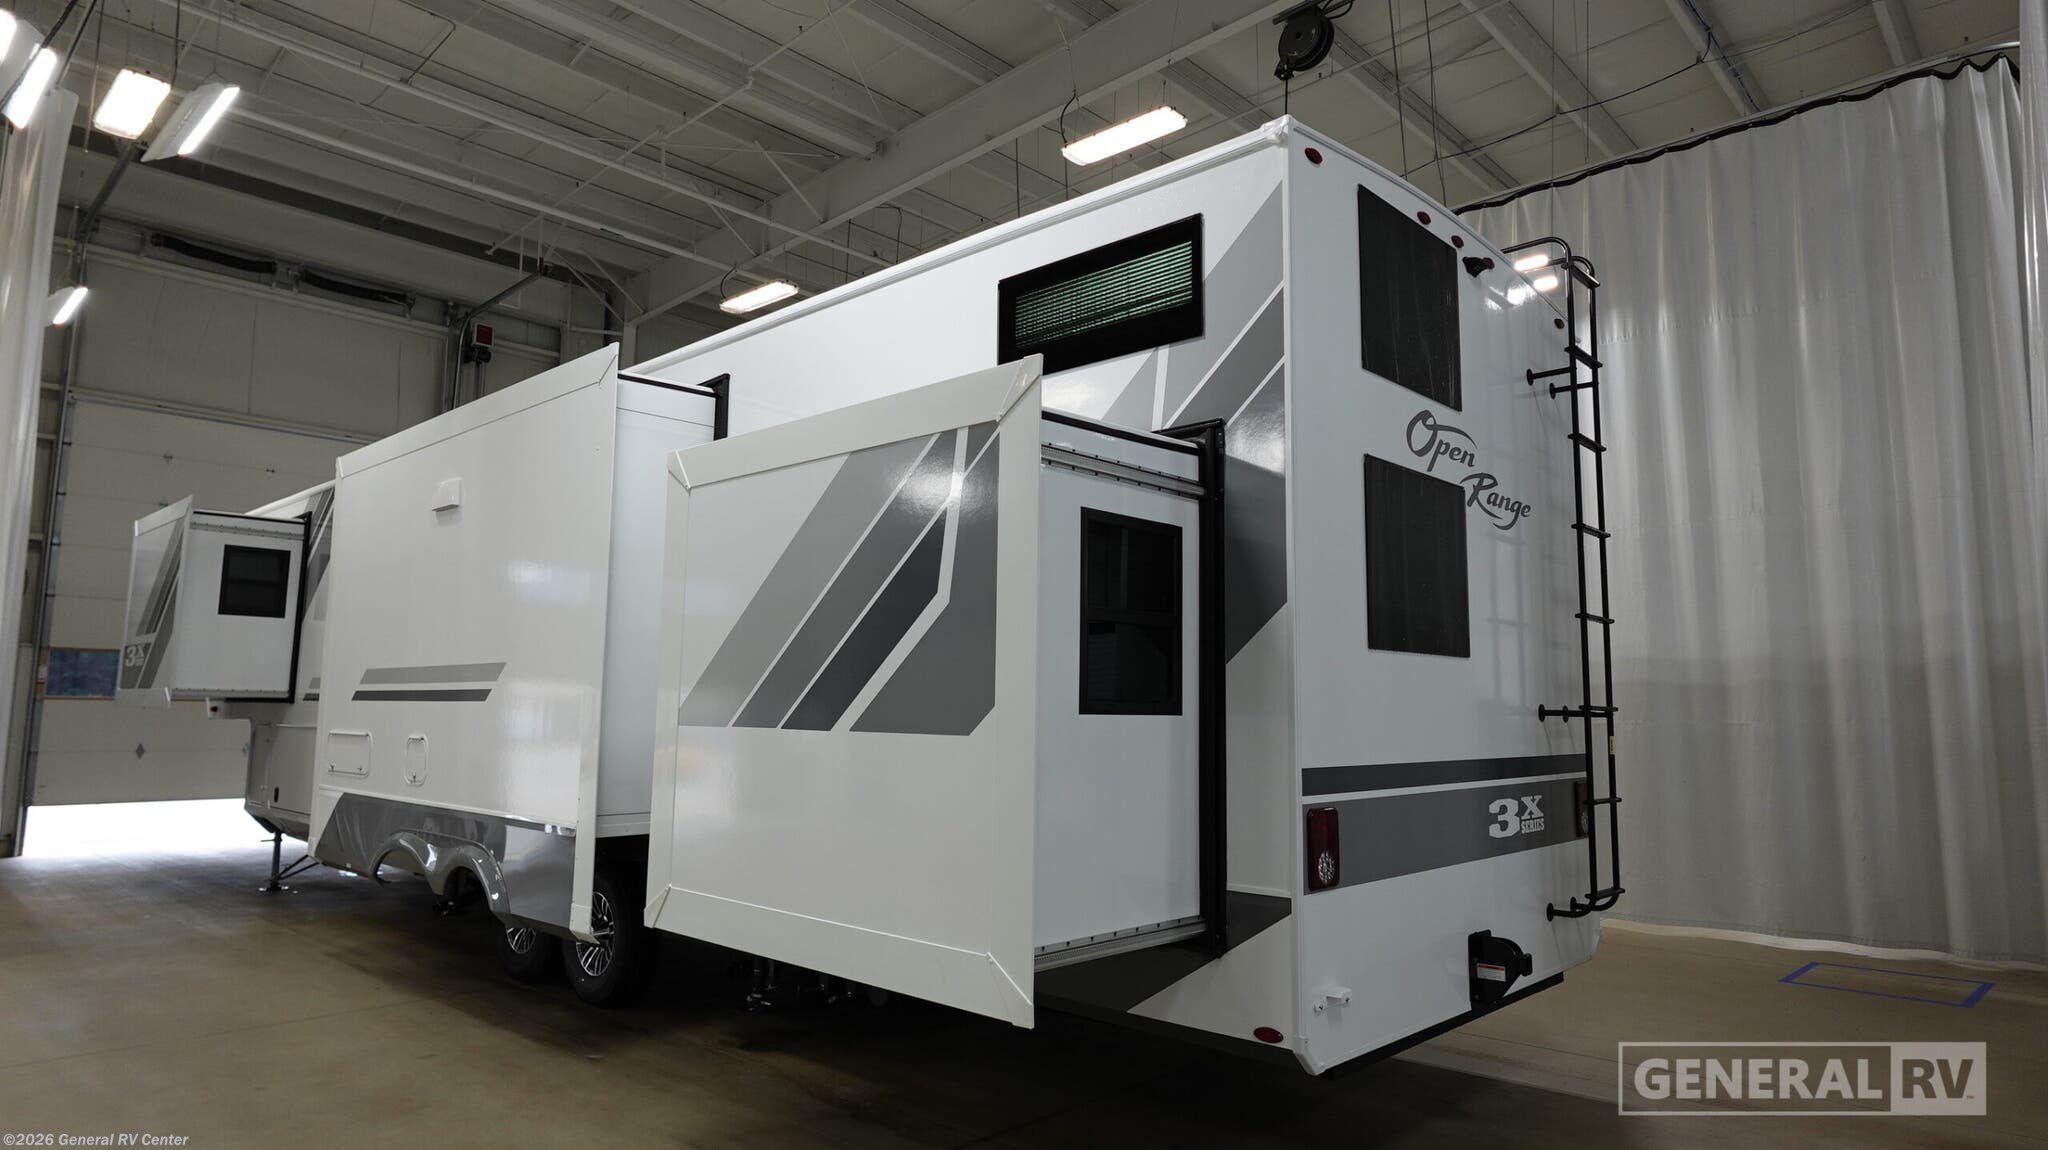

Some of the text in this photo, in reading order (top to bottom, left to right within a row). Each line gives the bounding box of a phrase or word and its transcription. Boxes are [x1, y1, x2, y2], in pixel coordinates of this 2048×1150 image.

[1406, 409, 1477, 472] Open
[1459, 472, 1531, 531] Range
[1520, 818, 1545, 834] SERIES
